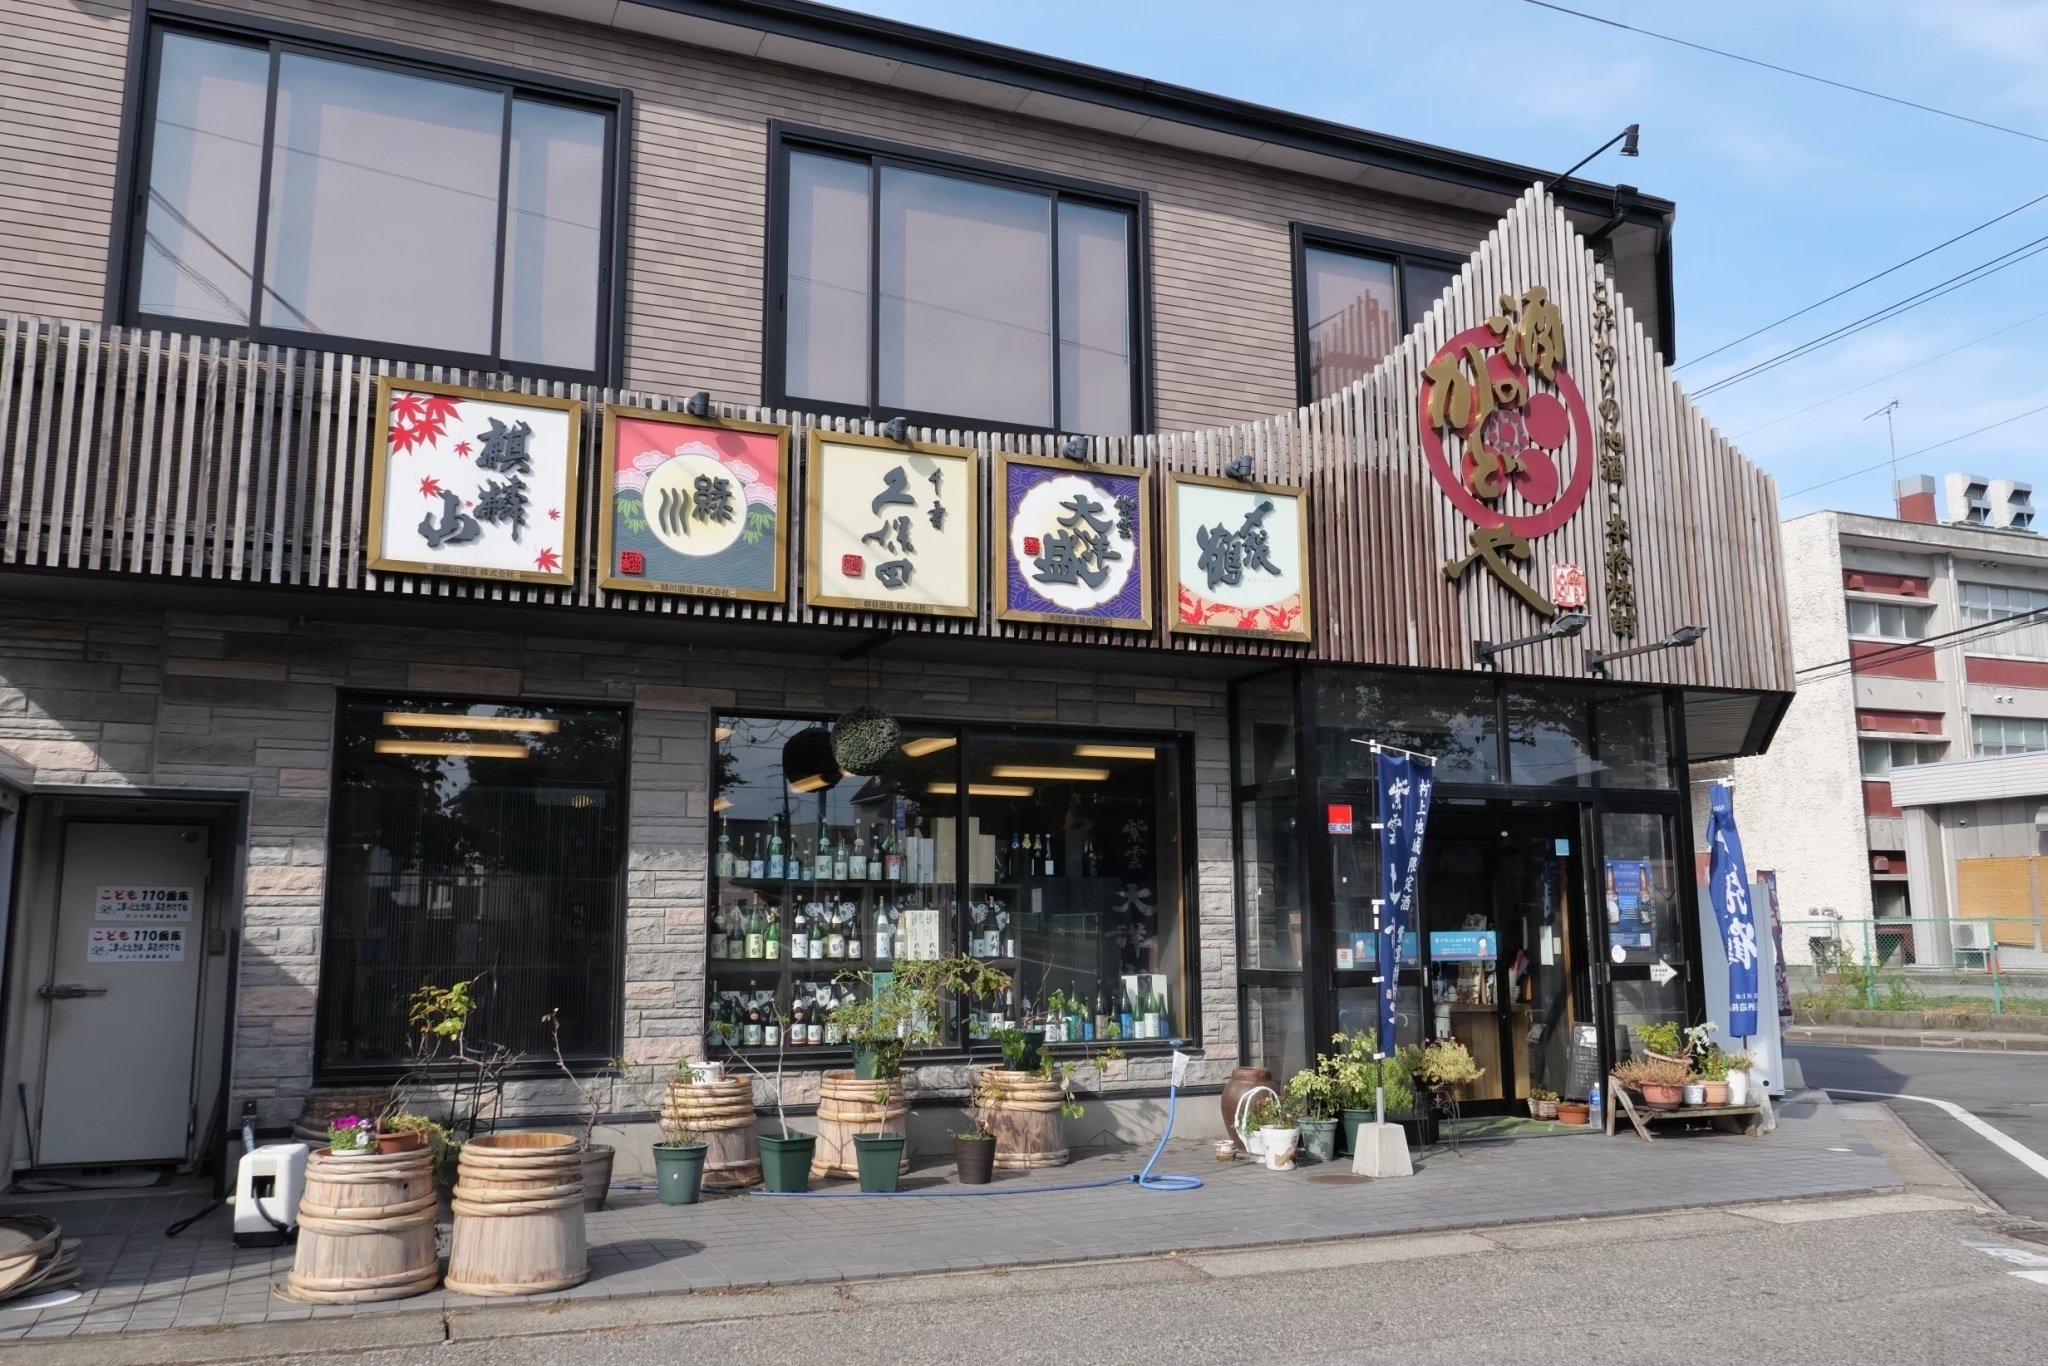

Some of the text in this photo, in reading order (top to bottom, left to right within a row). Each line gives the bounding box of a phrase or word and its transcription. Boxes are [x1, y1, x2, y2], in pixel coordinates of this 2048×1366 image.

[418, 416, 533, 549] 麒麟山
[860, 464, 919, 590] 久保田
[1033, 493, 1122, 589] 大洋盛
[93, 931, 130, 941] こども
[101, 890, 138, 901] こども
